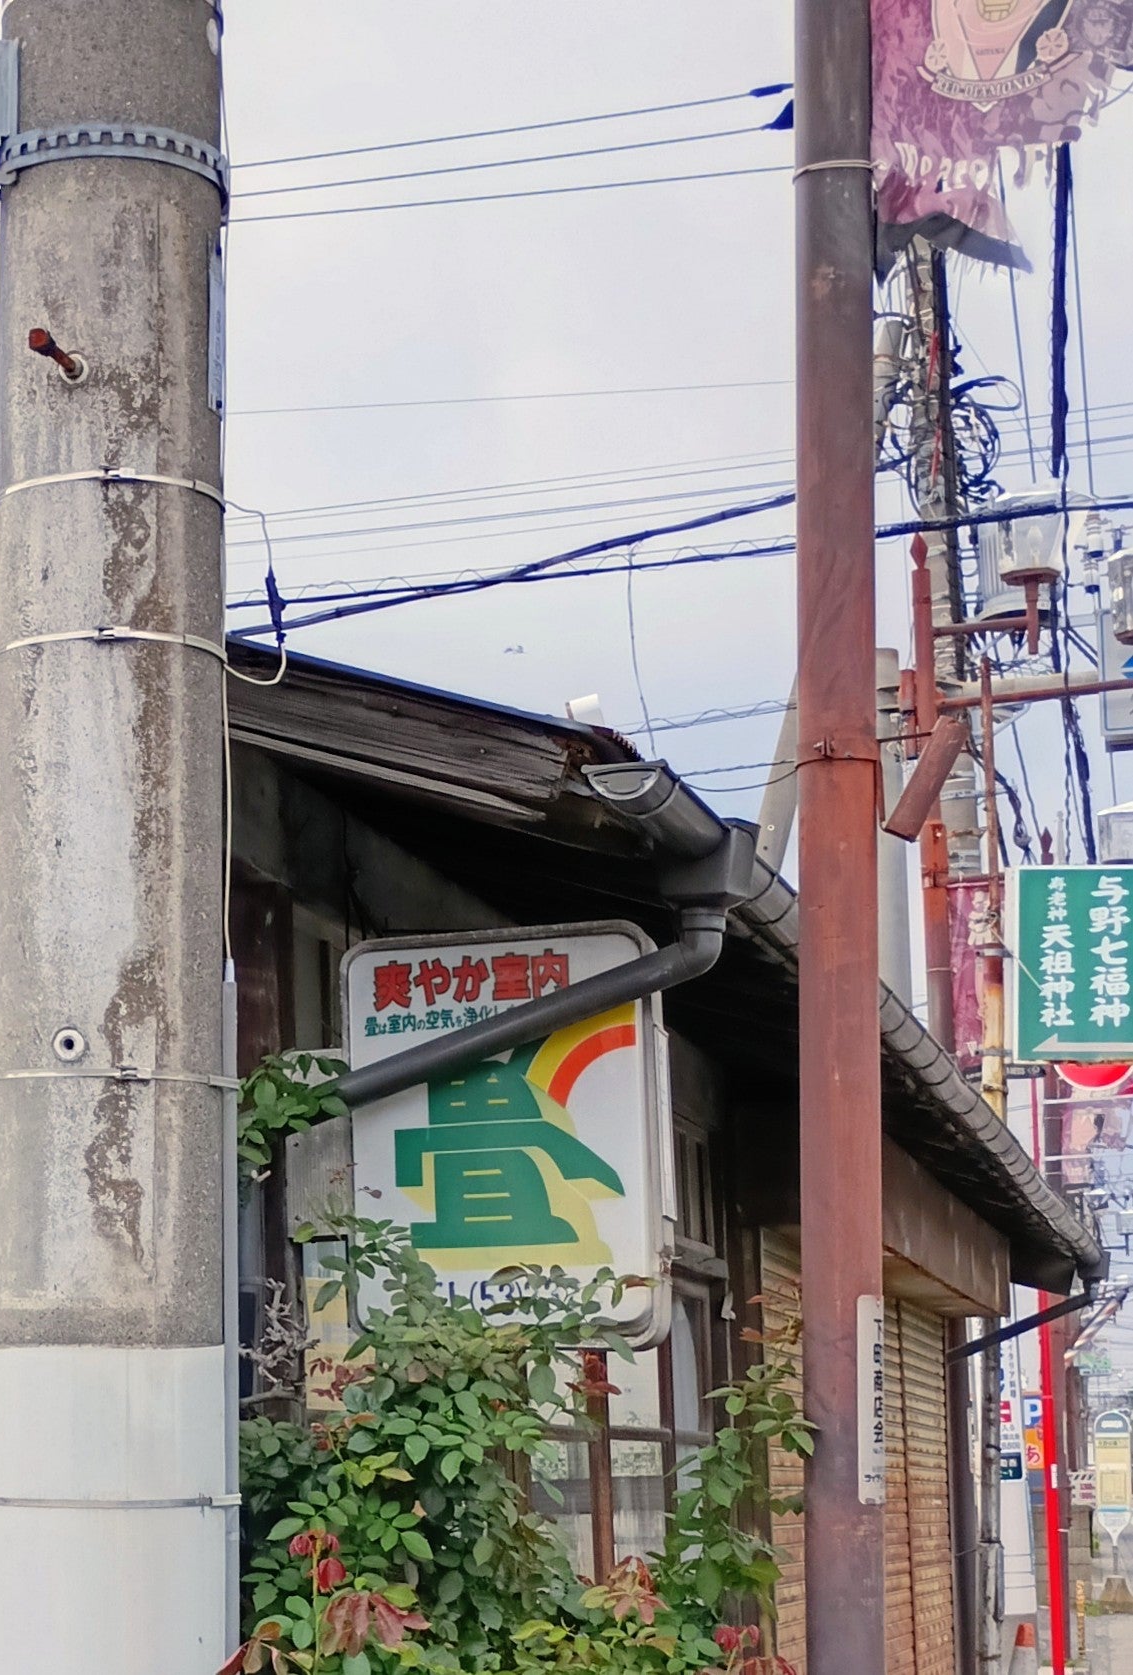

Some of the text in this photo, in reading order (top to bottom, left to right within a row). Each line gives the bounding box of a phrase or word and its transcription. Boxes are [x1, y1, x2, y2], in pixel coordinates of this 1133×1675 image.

[373, 948, 569, 1012] 爽やか室内
[1039, 924, 1075, 1027] 天祖神社
[1088, 875, 1131, 1027] 与野七福神
